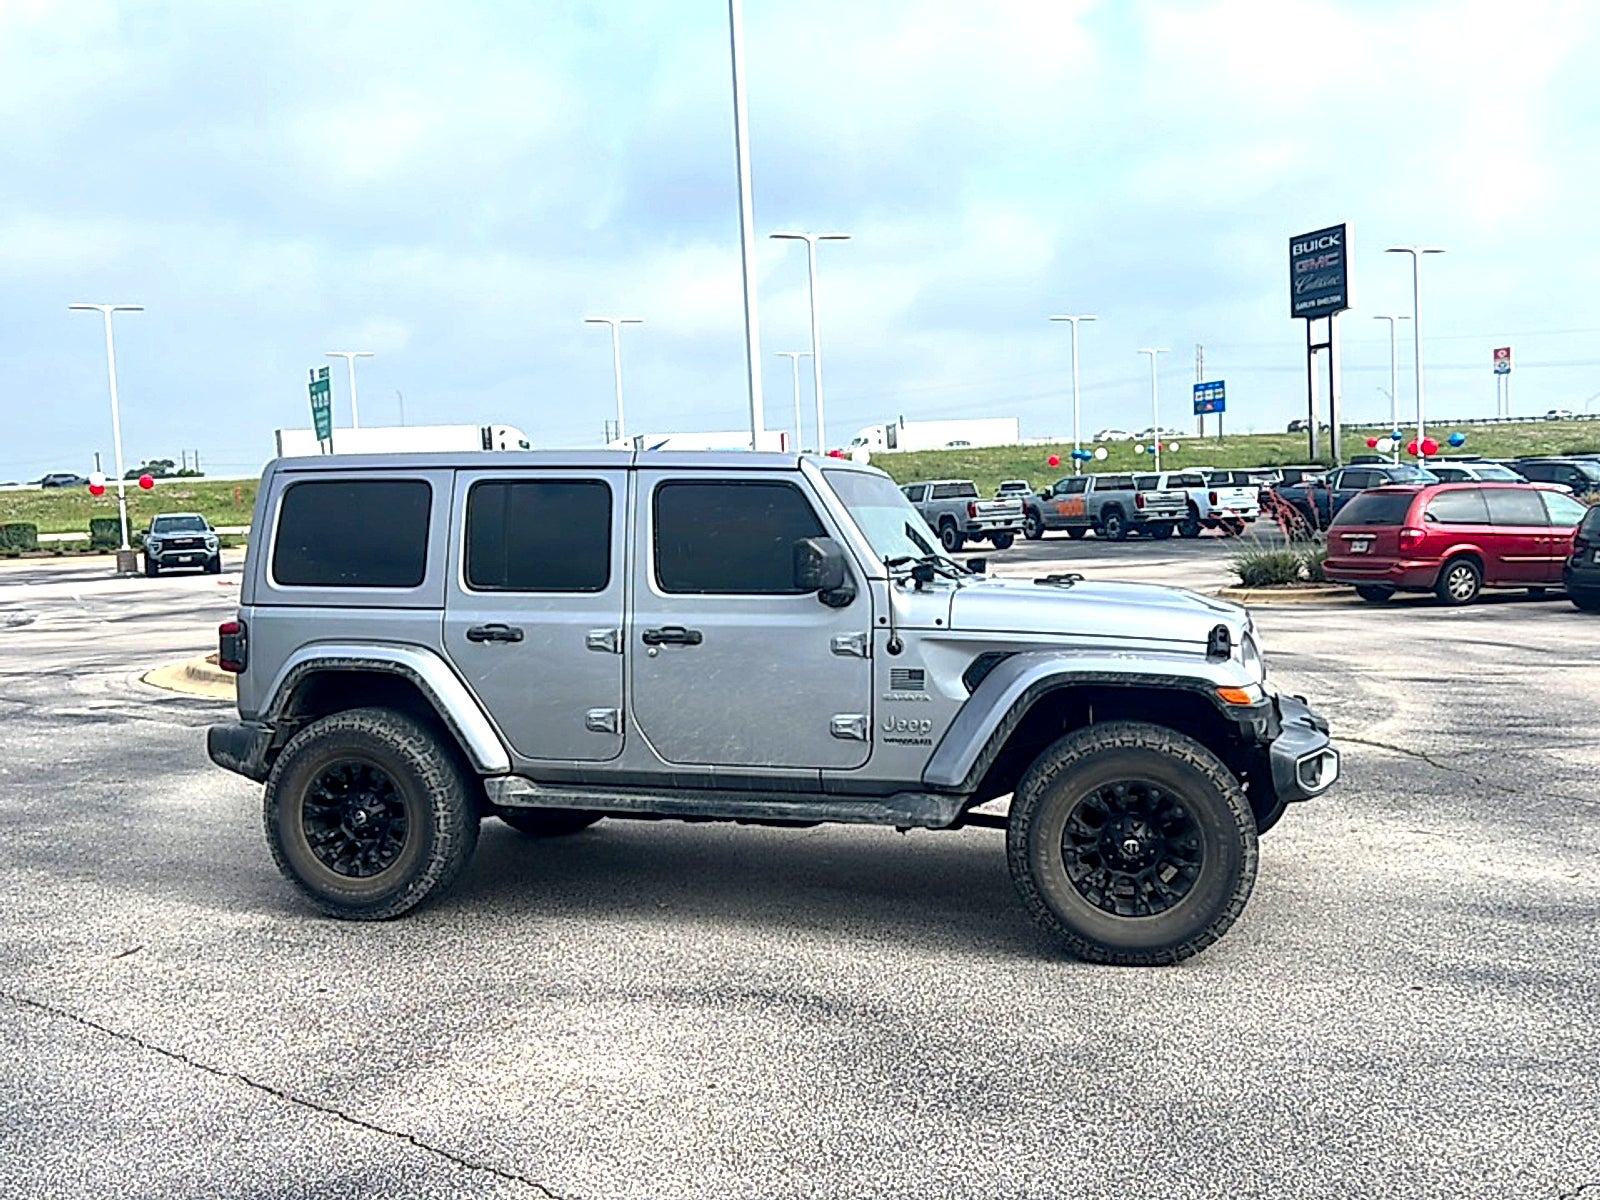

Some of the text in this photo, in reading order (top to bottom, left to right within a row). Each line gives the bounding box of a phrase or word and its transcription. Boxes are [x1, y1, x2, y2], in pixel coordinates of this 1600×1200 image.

[1293, 233, 1341, 256] BUICK
[1296, 252, 1339, 273] GMC
[882, 715, 932, 735] Jeep
